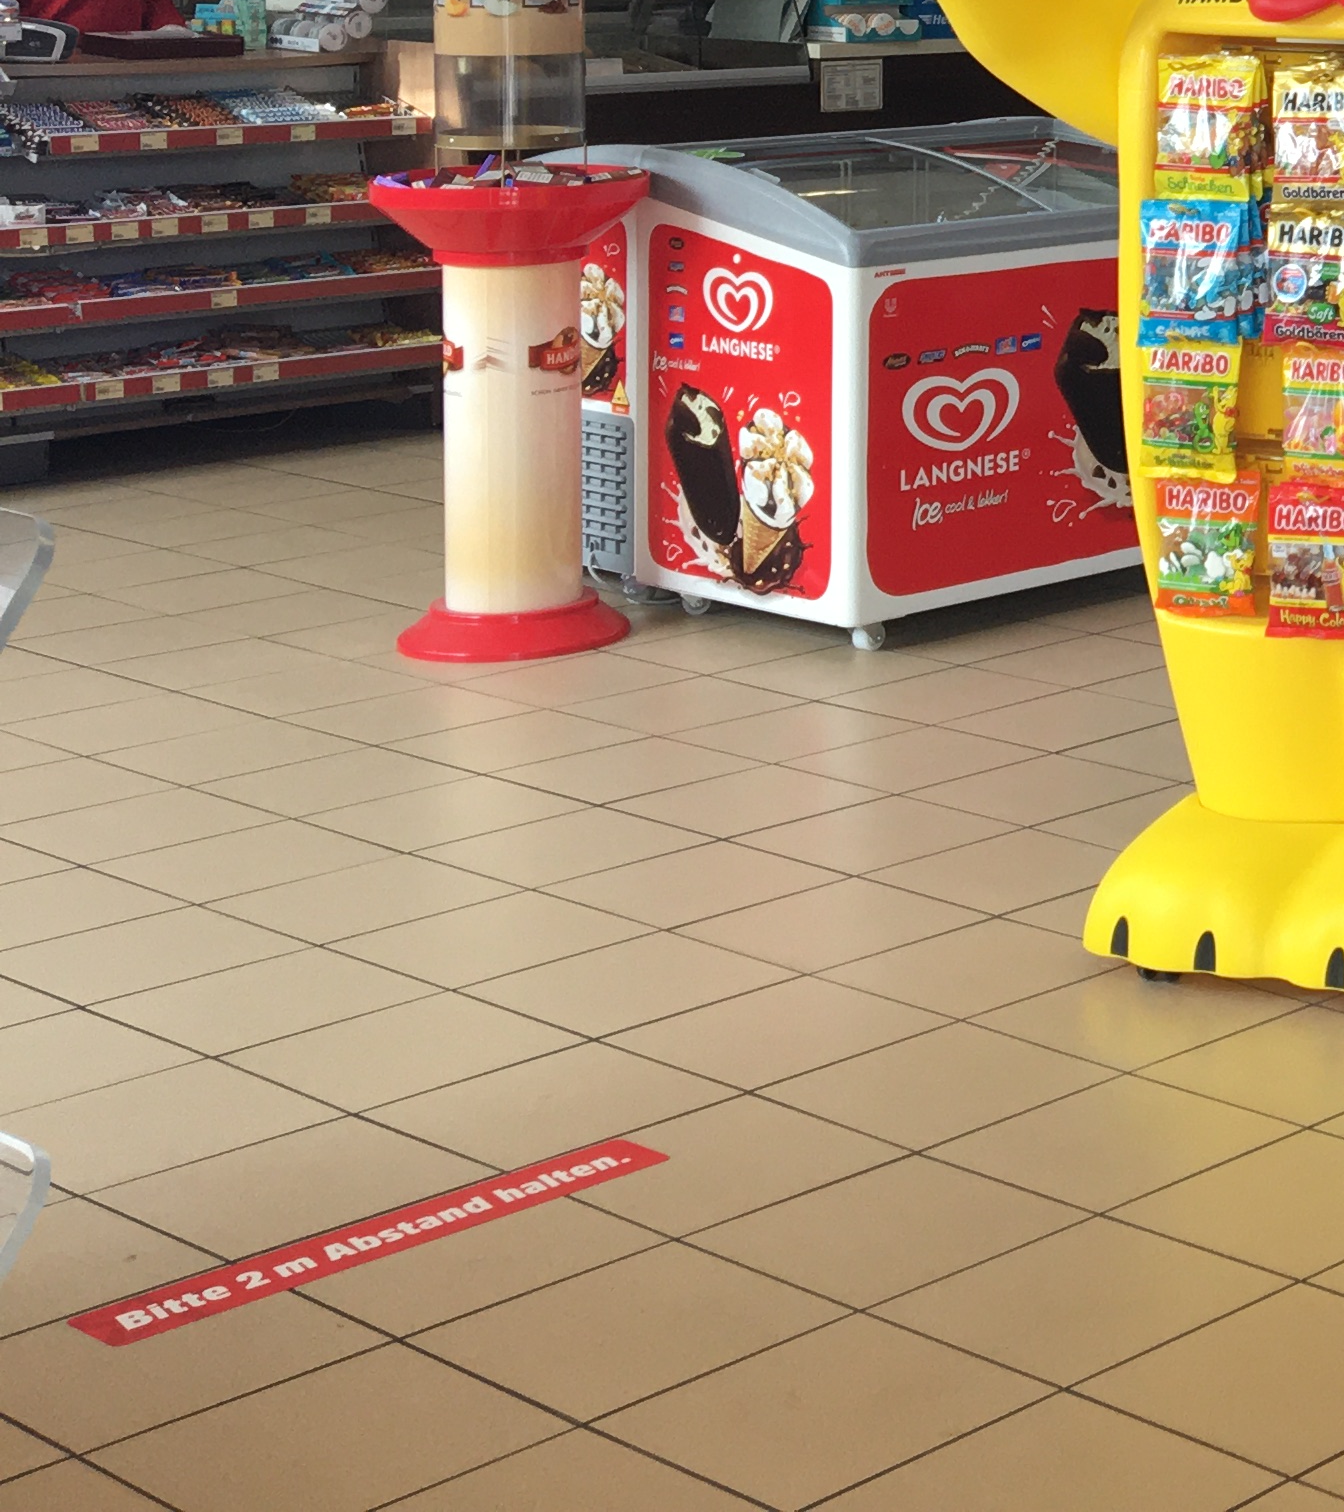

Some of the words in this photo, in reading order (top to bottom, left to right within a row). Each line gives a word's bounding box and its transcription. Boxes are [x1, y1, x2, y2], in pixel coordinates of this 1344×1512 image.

[1170, 75, 1245, 99] HARIBO
[1308, 305, 1335, 321] Saft
[1276, 324, 1344, 342] Goldbären
[702, 334, 774, 361] LANGNESE
[1151, 349, 1230, 376] HARIBO
[900, 449, 1020, 491] LANGNESE
[912, 497, 944, 531] Ice,
[945, 494, 966, 513] cool
[966, 495, 975, 510] &
[1165, 486, 1249, 514] HARIBO
[116, 1285, 231, 1332] Bitte
[235, 1269, 271, 1290] 2
[273, 1256, 319, 1279] m
[323, 1195, 493, 1263] Abstand
[494, 1152, 631, 1205] halten.
